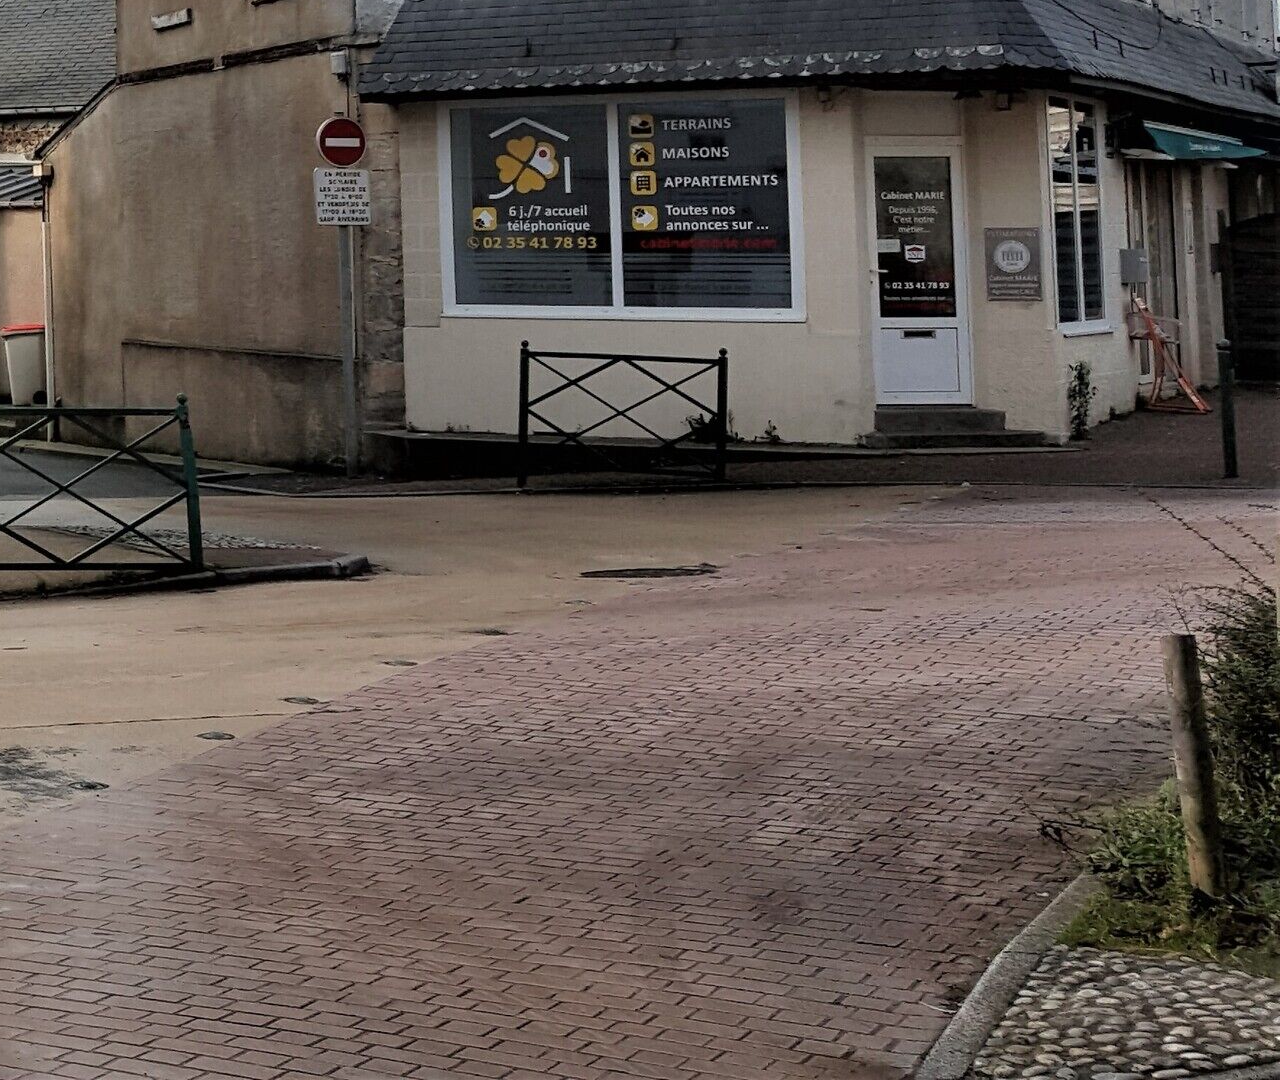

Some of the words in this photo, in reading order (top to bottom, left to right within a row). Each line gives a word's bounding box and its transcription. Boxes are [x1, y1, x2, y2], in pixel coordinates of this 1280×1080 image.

[661, 117, 732, 132] TERRAINS
[661, 146, 730, 160] MAISONS
[663, 174, 779, 189] APPARTEMENTS
[880, 191, 915, 200] Cabinet
[915, 191, 945, 200] MARIE
[508, 206, 517, 216] 6
[544, 204, 588, 217] accueil
[665, 204, 711, 216] Toutes
[714, 206, 736, 216] nos
[888, 205, 916, 215] Depuis
[507, 219, 591, 233] téléphonique
[665, 220, 729, 231] annonces
[731, 221, 753, 231] sur
[483, 237, 503, 249] 02
[506, 237, 526, 249] 35
[529, 237, 550, 249] 41
[553, 237, 574, 249] 78
[577, 236, 598, 248] 93
